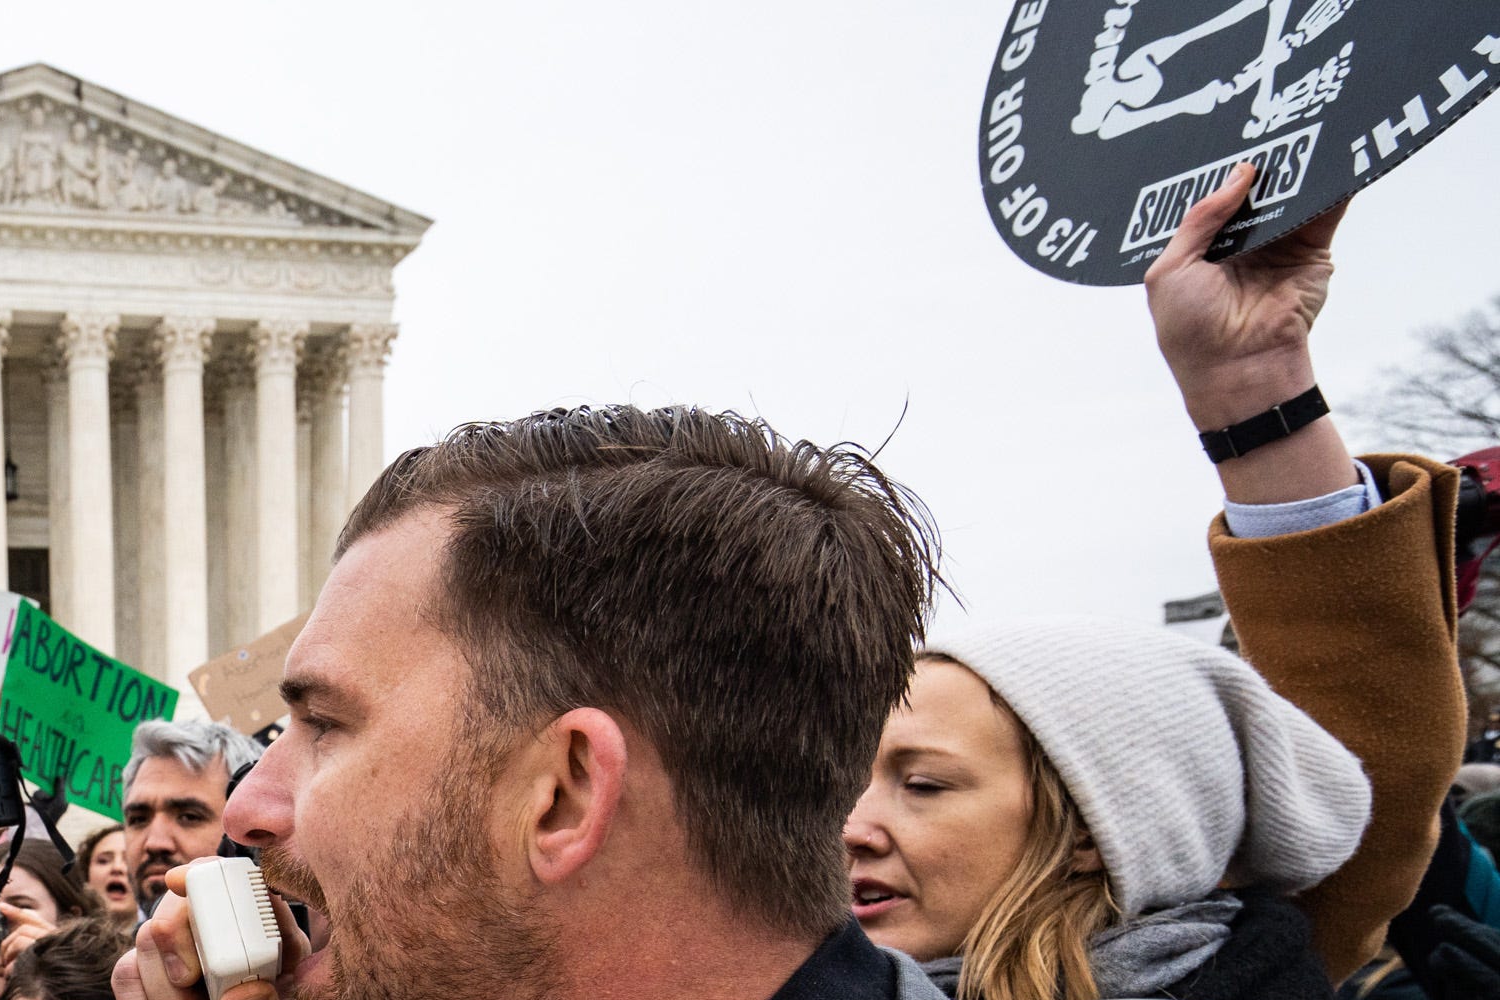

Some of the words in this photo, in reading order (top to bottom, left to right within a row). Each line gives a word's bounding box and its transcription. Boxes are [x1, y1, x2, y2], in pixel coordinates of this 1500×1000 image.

[988, 77, 1026, 185] OUR
[999, 183, 1049, 237] OF
[1037, 217, 1098, 268] 1/3
[1129, 134, 1311, 243] SURVIORS
[1223, 206, 1285, 234] olocaust!
[9, 609, 169, 723] ABORTION
[2, 698, 124, 812] HEALTHCAR
